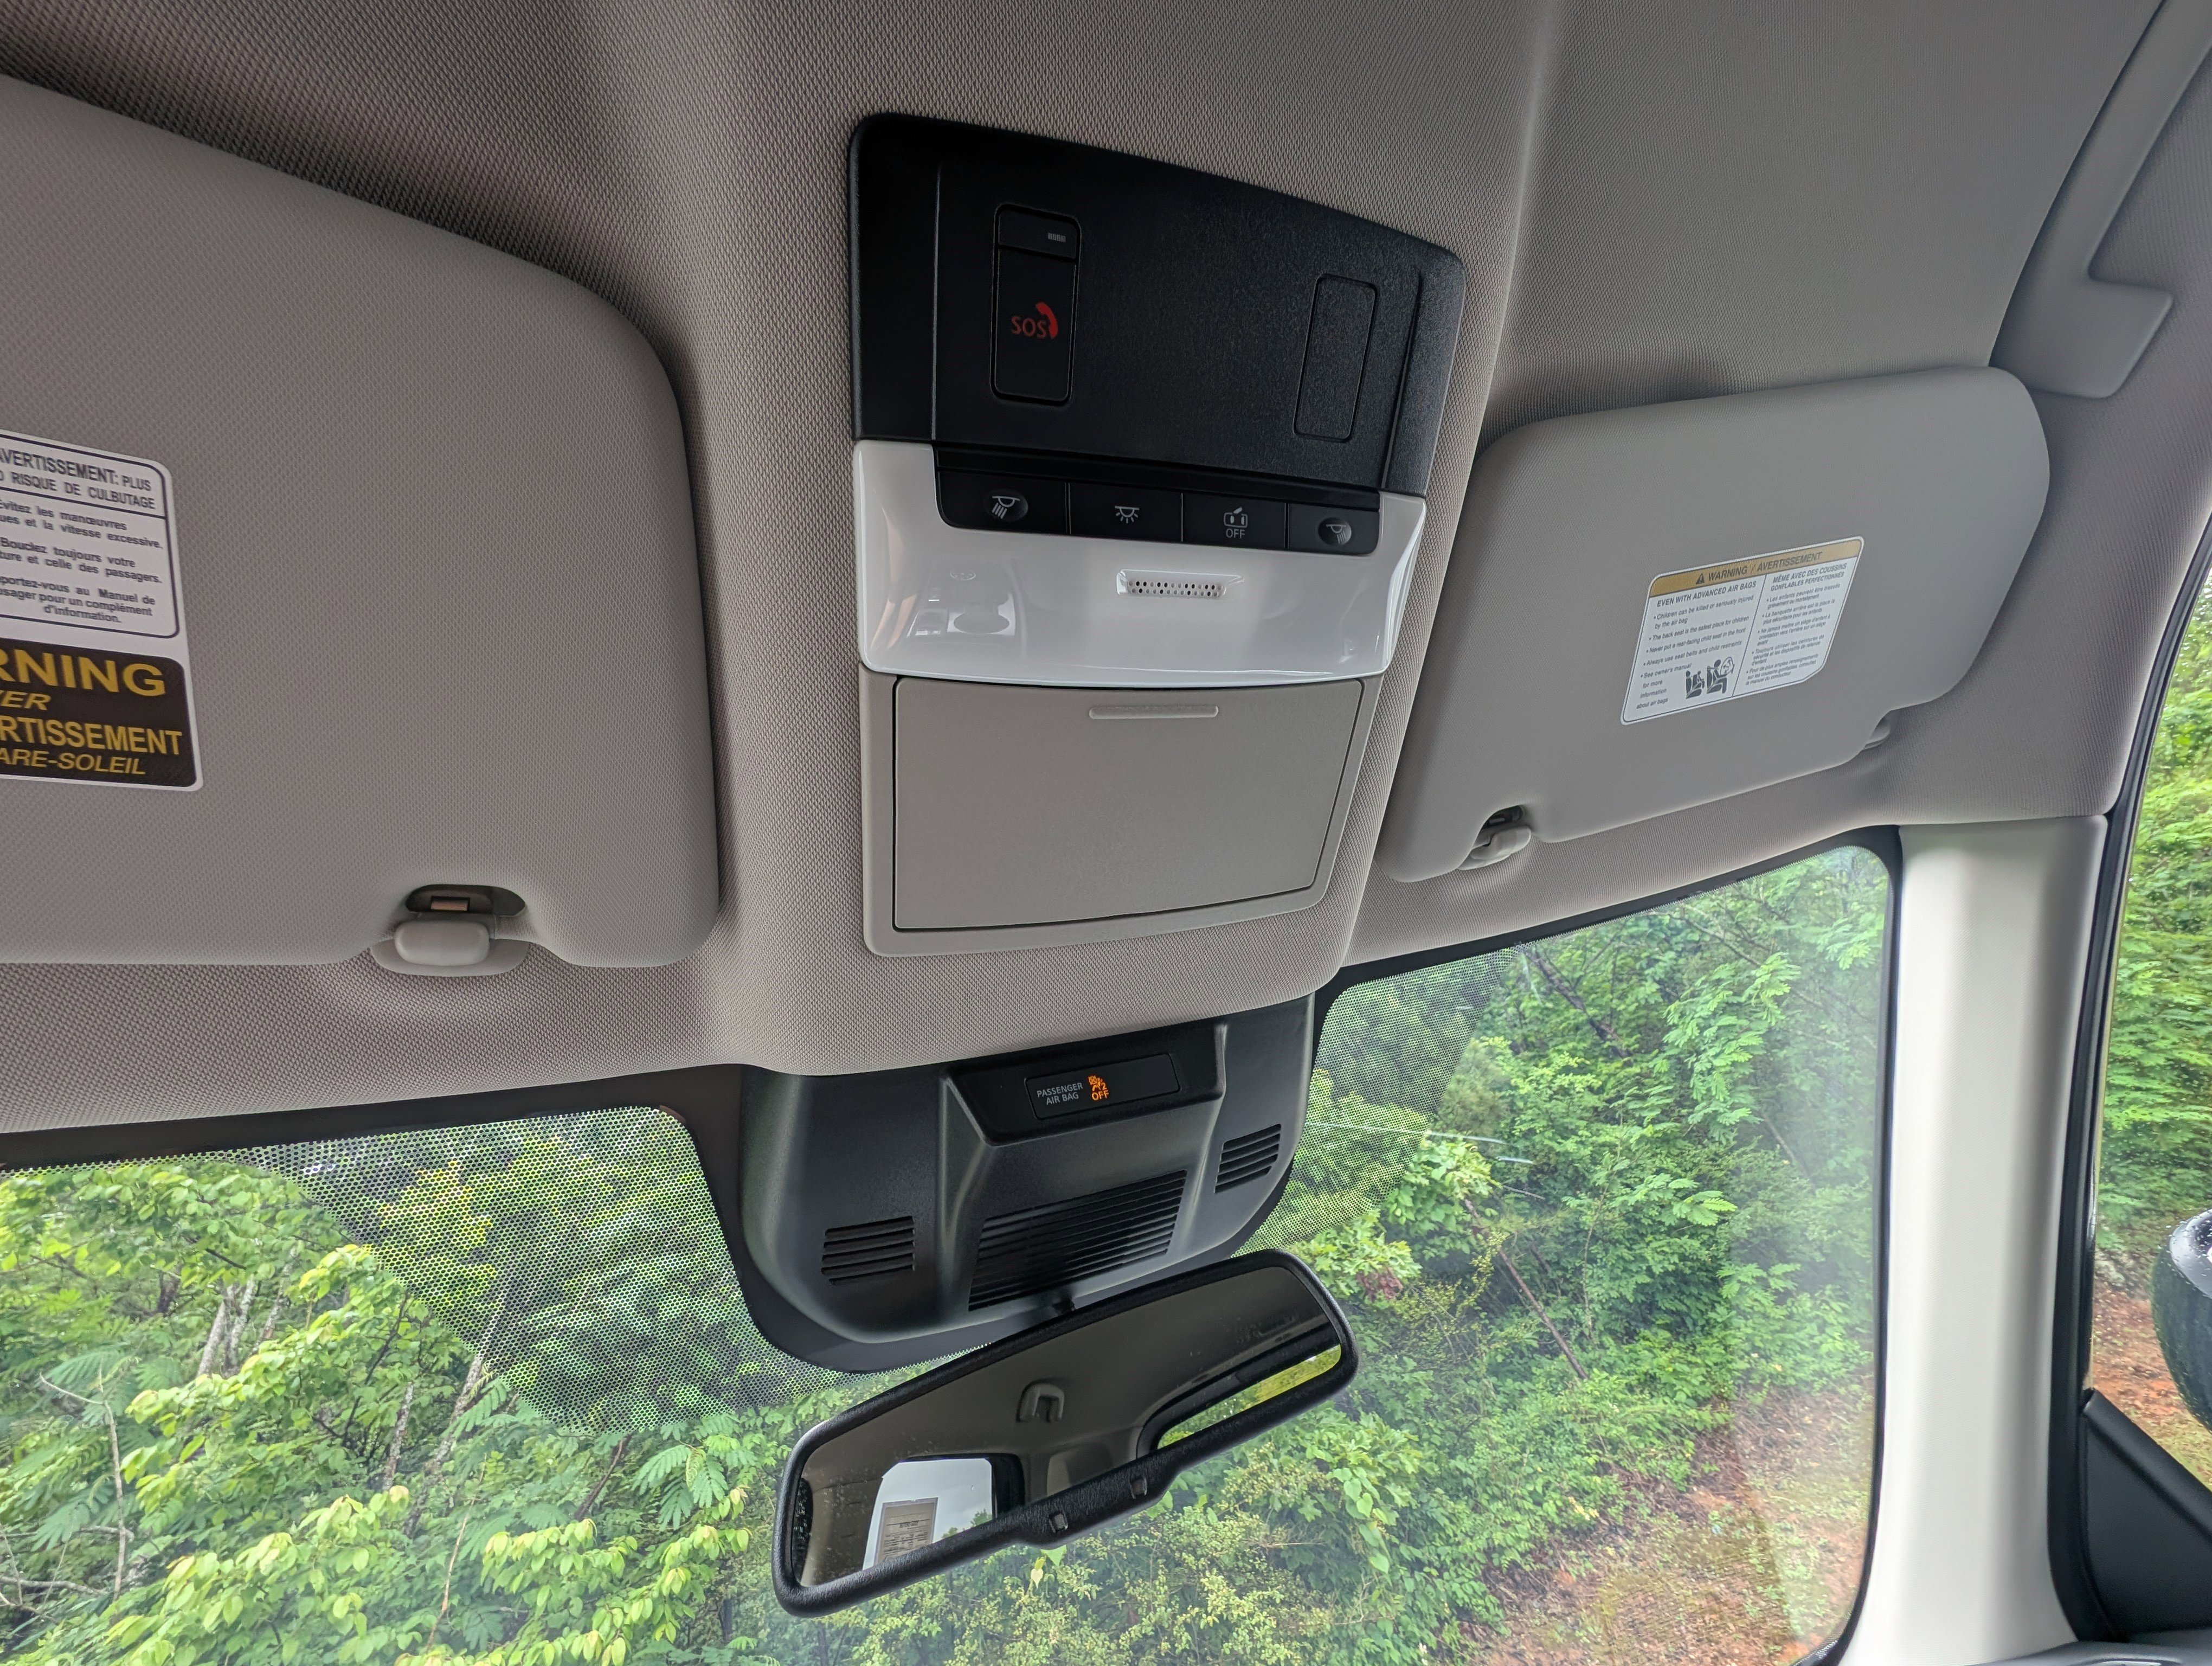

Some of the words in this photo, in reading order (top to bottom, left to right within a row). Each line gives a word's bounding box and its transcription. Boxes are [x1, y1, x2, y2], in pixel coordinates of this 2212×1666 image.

[1011, 315, 1047, 339] SOS
[11, 471, 57, 491] RISQUE
[63, 482, 81, 496] DE
[88, 486, 156, 509] CULBUTAGE
[121, 475, 152, 491] PLUS
[25, 518, 37, 528] et
[60, 524, 101, 538] vitesse
[107, 533, 163, 549] excessive.
[1225, 528, 1245, 539] OFF
[53, 547, 102, 562] toujours
[107, 556, 136, 567] votre
[27, 555, 40, 564] et
[45, 558, 72, 569] celle
[78, 562, 99, 574] des
[105, 568, 163, 583] passagers.
[1708, 566, 1747, 581] WARNING
[1757, 552, 1823, 572] AVERTISSEMENT
[1791, 569, 1806, 581] AVEC
[1806, 567, 1818, 577] DES
[1657, 597, 1674, 607] EVEN
[1676, 594, 1692, 603] WITH
[1693, 587, 1726, 599] ADVANCED
[1727, 584, 1739, 592] AIR
[1740, 580, 1757, 590] BAGS
[1771, 580, 1804, 592] GONFLABLES
[39, 593, 66, 603] pour
[69, 598, 83, 606] un
[75, 587, 91, 596] au
[98, 588, 138, 603] Manuel
[142, 595, 156, 605] de
[1037, 1082, 1083, 1098] PASSENGER
[1046, 1096, 1060, 1105] AIR
[1062, 1092, 1079, 1102] BAG
[1091, 1090, 1109, 1101] OFF
